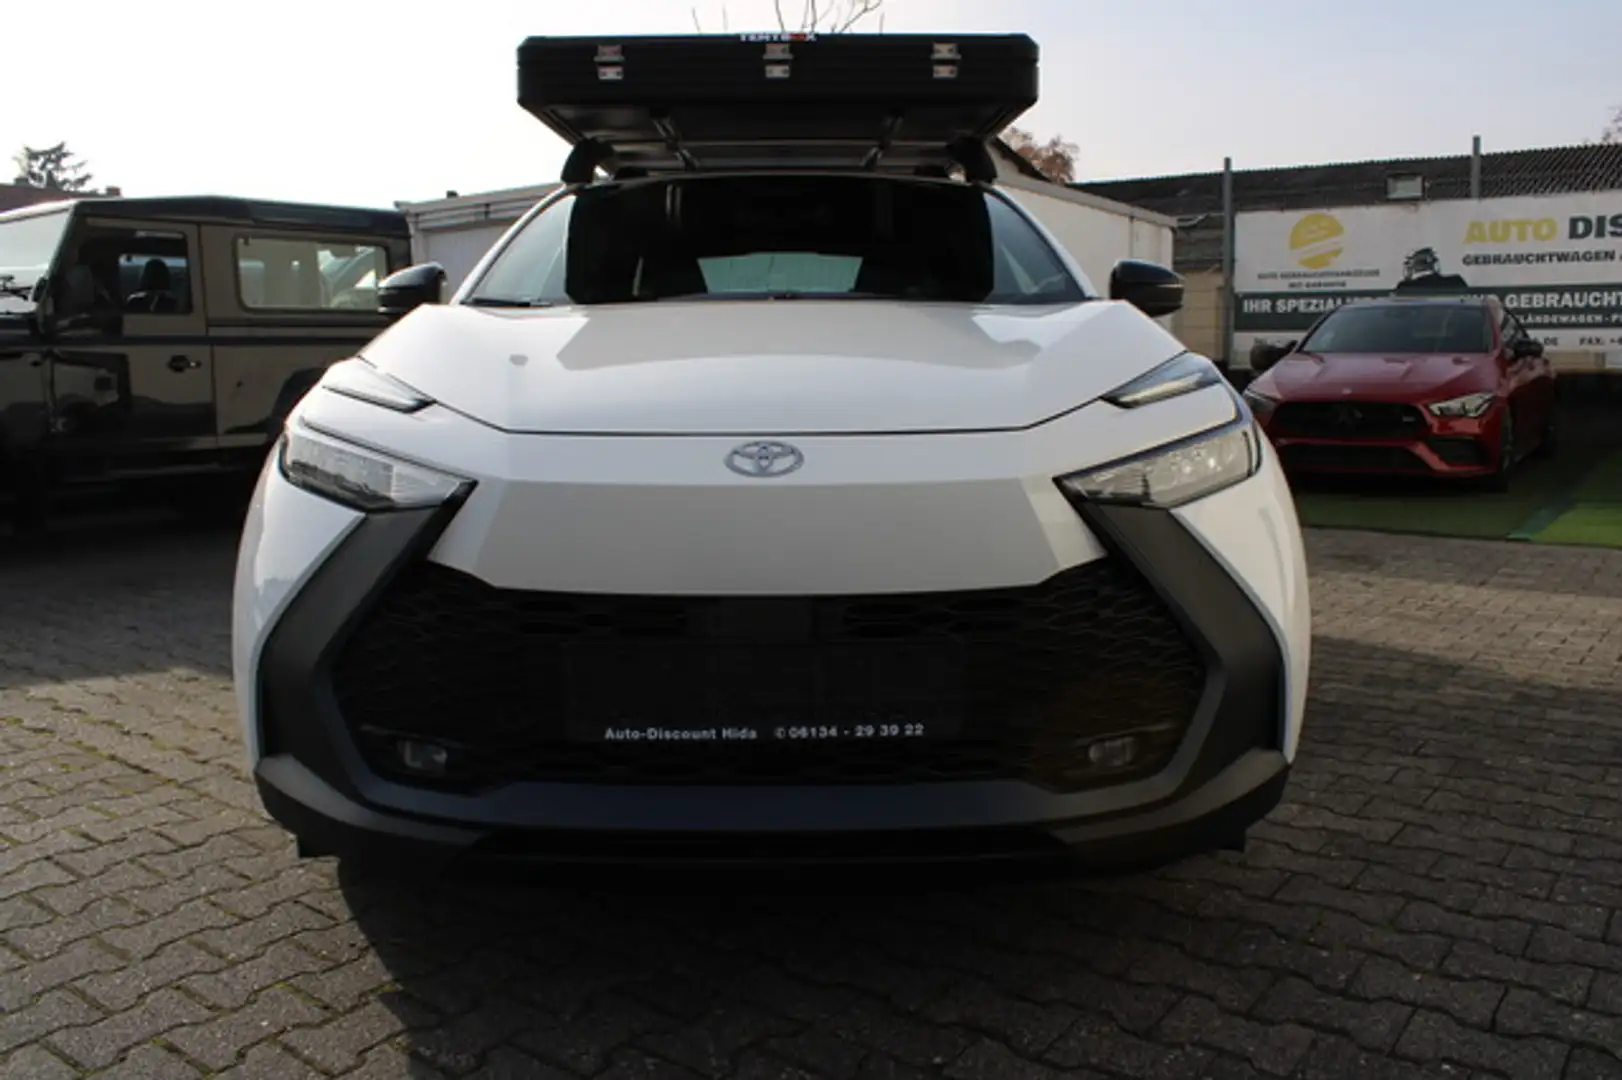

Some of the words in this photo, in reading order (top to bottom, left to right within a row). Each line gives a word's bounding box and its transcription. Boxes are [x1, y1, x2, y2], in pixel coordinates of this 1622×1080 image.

[1463, 217, 1558, 244] AUTO
[1462, 249, 1615, 266] GEBRAUCHTWAGEN
[1243, 298, 1271, 313] IHR
[604, 727, 717, 740] Auto-Discount
[722, 727, 758, 740] Hida
[788, 725, 838, 739] 06134
[854, 724, 875, 737] 29
[879, 724, 900, 737] 39
[904, 723, 924, 736] 22
